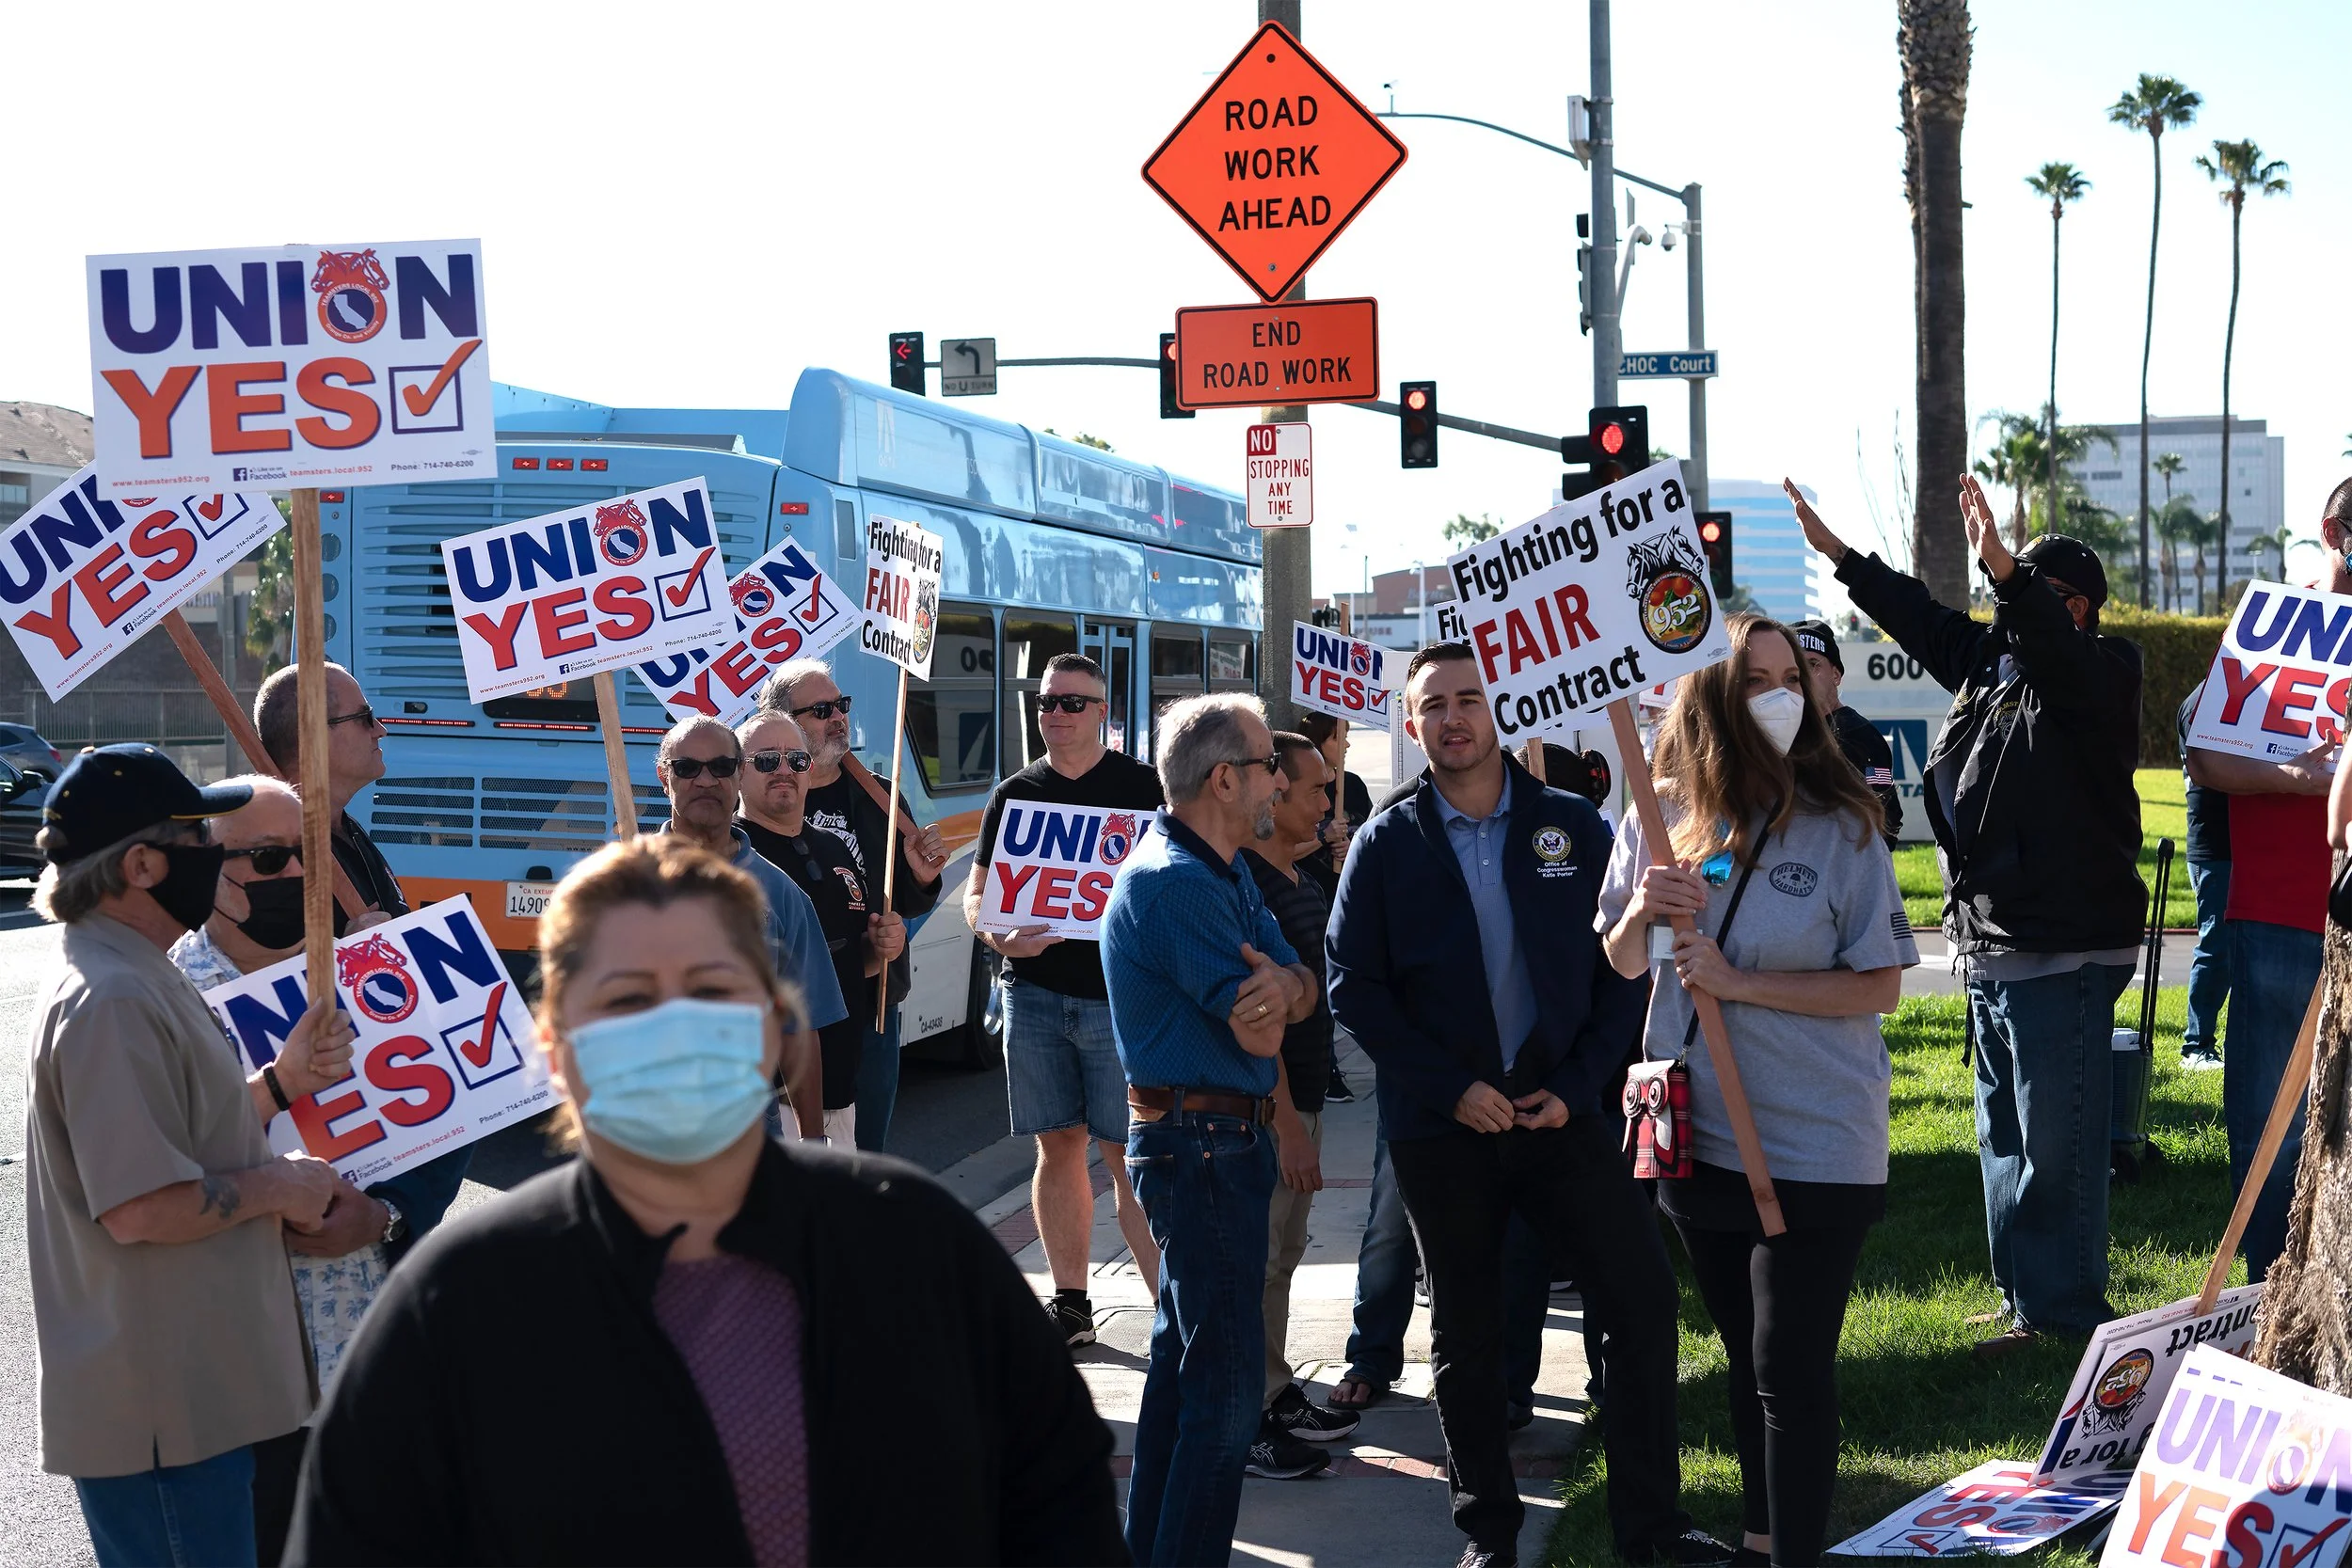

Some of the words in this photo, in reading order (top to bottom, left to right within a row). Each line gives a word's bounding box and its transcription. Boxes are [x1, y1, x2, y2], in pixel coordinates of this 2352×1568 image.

[1225, 95, 1318, 132] ROAD
[1224, 145, 1320, 181] WORK
[1217, 195, 1331, 232] AHEAD
[101, 250, 479, 354] UNION
[321, 283, 351, 307] TEAMSTERS
[1252, 321, 1301, 348] END
[1203, 361, 1269, 388] ROAD
[1281, 356, 1352, 385] WORK
[1670, 355, 1711, 372] Court
[959, 381, 968, 391] U
[100, 356, 382, 459] YES
[1250, 428, 1273, 451] NO
[111, 475, 210, 487] www.teamsters952.org
[249, 472, 287, 481] Facebook
[290, 466, 373, 477] teamsters.local.952
[423, 460, 474, 469] 714-740-6200
[1250, 458, 1310, 480] STOPPING
[1267, 500, 1293, 515] TIME
[1268, 482, 1292, 497] ANY
[0, 473, 125, 605] UNI
[215, 547, 236, 564] Phone:
[235, 523, 268, 549] 714-740-6200
[453, 488, 712, 603] UNION
[870, 521, 918, 573] Fighting
[919, 535, 933, 571] for
[934, 549, 942, 574] a
[1452, 515, 1600, 603] Fighting
[1599, 486, 1654, 539] for
[1660, 478, 1686, 513] a
[13, 509, 198, 660] YES
[134, 608, 157, 628] Facebook
[156, 569, 207, 610] teamsters.local.952
[866, 567, 911, 624] FAIR
[461, 575, 655, 672] YES
[639, 545, 818, 689] UON
[1653, 594, 1701, 636] 952
[2236, 591, 2352, 667] UNI
[664, 638, 687, 647] Phone:
[687, 628, 722, 641] 714-740-6200
[862, 619, 912, 666] Contract
[1471, 583, 1601, 686] FAIR
[1798, 634, 1825, 653] STERS
[56, 641, 114, 689] www.teamsters952.org
[570, 660, 596, 672] Facebook
[596, 645, 654, 664] teamsters.local.952
[667, 616, 803, 717] YES
[1867, 653, 1924, 681] 600
[479, 673, 546, 694] www.teamsters952.org
[1295, 660, 1365, 711] YES
[1494, 644, 1646, 736] Contract
[2221, 657, 2352, 746] YES
[2197, 733, 2254, 750] www.teamsters952.org
[994, 862, 1113, 922] YES
[1775, 878, 1812, 895] HARDHATS
[1777, 865, 1815, 883] HELMETS
[356, 969, 374, 998] TEAMSTERS
[288, 1035, 455, 1164] ES
[479, 1109, 506, 1125] Phone:
[505, 1089, 548, 1114] 714-740-6200
[358, 1160, 393, 1180] Facebook
[393, 1125, 466, 1163] teamsters.local.952
[2166, 1302, 2261, 1357] ontract
[2105, 1369, 2143, 1391] 952
[2058, 1448, 2081, 1469] a
[2079, 1437, 2131, 1467] for
[2127, 1470, 2275, 1568] YES
